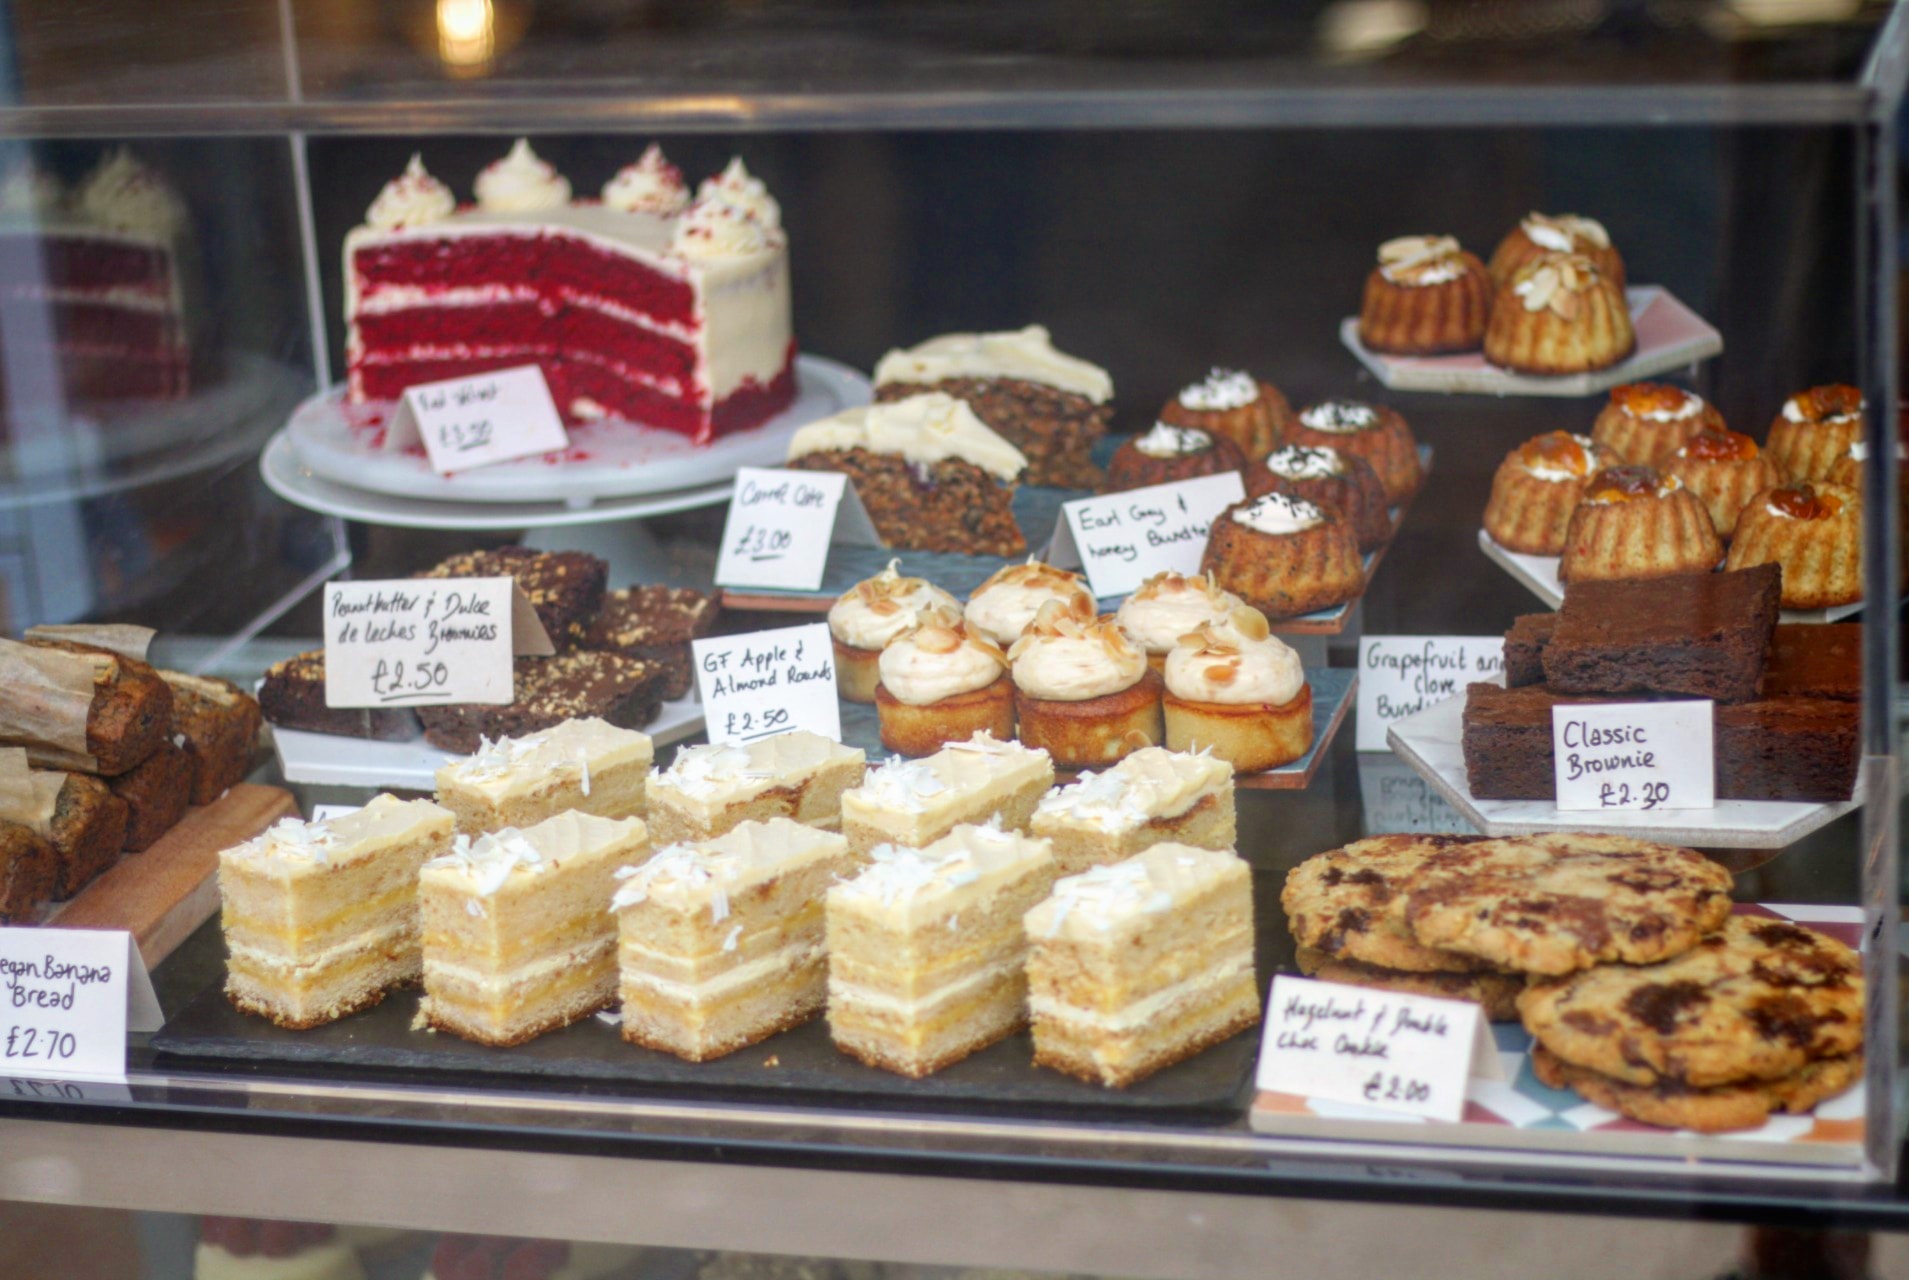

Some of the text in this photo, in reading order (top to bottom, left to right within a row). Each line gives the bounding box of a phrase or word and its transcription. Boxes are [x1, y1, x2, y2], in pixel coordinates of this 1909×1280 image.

[1078, 507, 1121, 531] Earl
[734, 525, 792, 555] £3.00
[442, 592, 492, 622] Dulce
[337, 621, 357, 644] de
[740, 645, 787, 673] Apple
[1366, 640, 1468, 682] Grapefruit
[370, 658, 450, 696] £2.50
[711, 659, 833, 699] Almond Rounds
[725, 707, 790, 736] £2.50
[1563, 720, 1649, 749] Classic
[1566, 750, 1657, 781] Brownie
[44, 955, 112, 985] Banana
[12, 982, 76, 1011] Bread
[5, 1026, 77, 1060] £2.70
